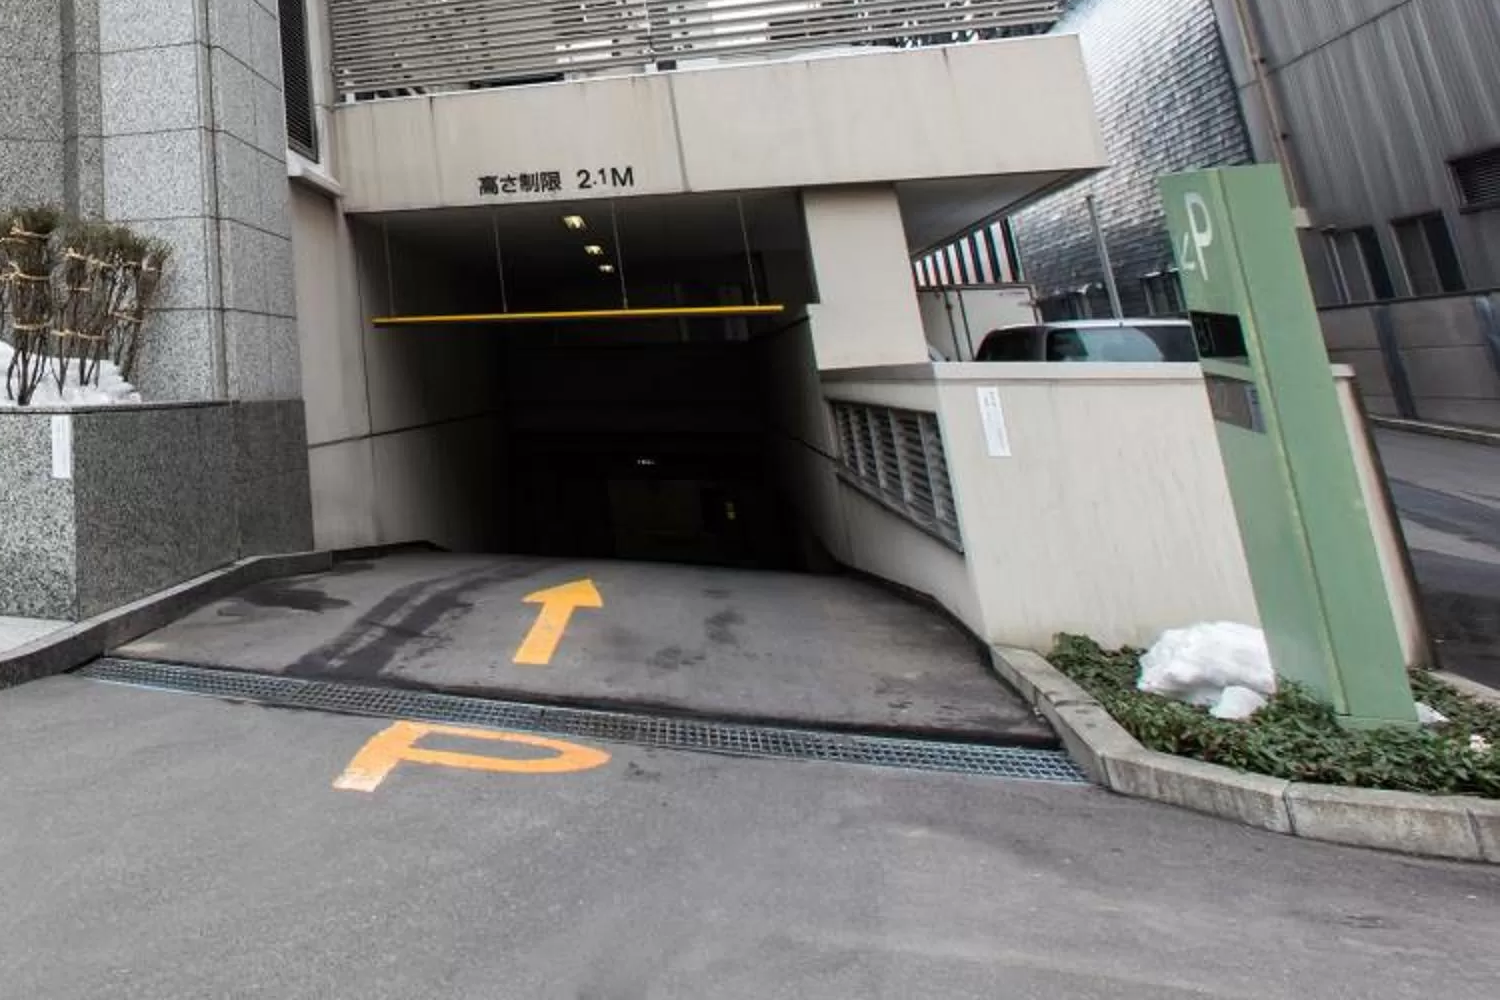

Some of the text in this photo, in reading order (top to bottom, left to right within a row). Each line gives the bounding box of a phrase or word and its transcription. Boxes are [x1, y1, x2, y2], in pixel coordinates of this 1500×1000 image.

[478, 166, 635, 195] 高さ制限 2.1M
[1184, 192, 1213, 281] P
[331, 719, 612, 792] P
